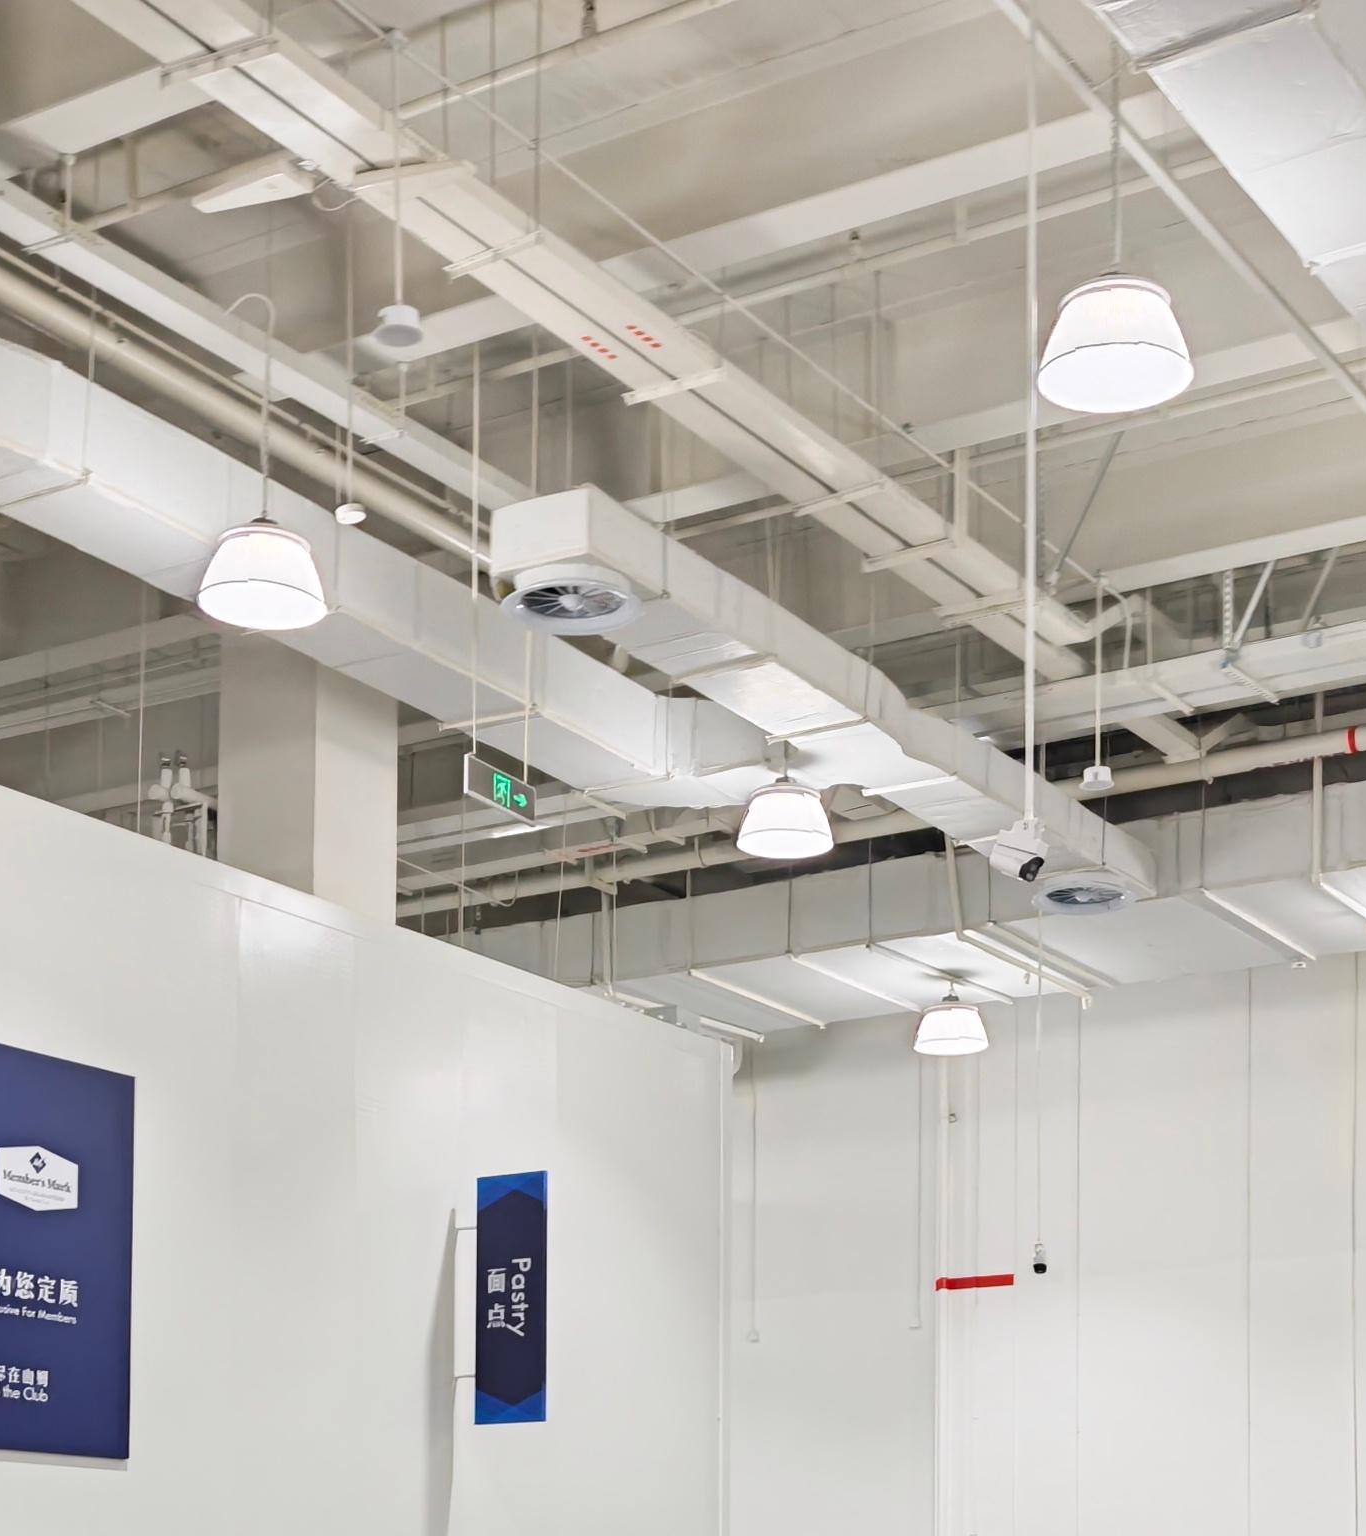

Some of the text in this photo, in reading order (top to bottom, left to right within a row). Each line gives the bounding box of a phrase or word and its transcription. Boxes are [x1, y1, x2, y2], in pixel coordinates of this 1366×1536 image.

[47, 1178, 72, 1194] Mark
[505, 1256, 532, 1337] Pastry
[21, 1306, 36, 1319] For
[37, 1309, 77, 1325] Members
[2, 1383, 21, 1400] the
[22, 1386, 49, 1403] Club
